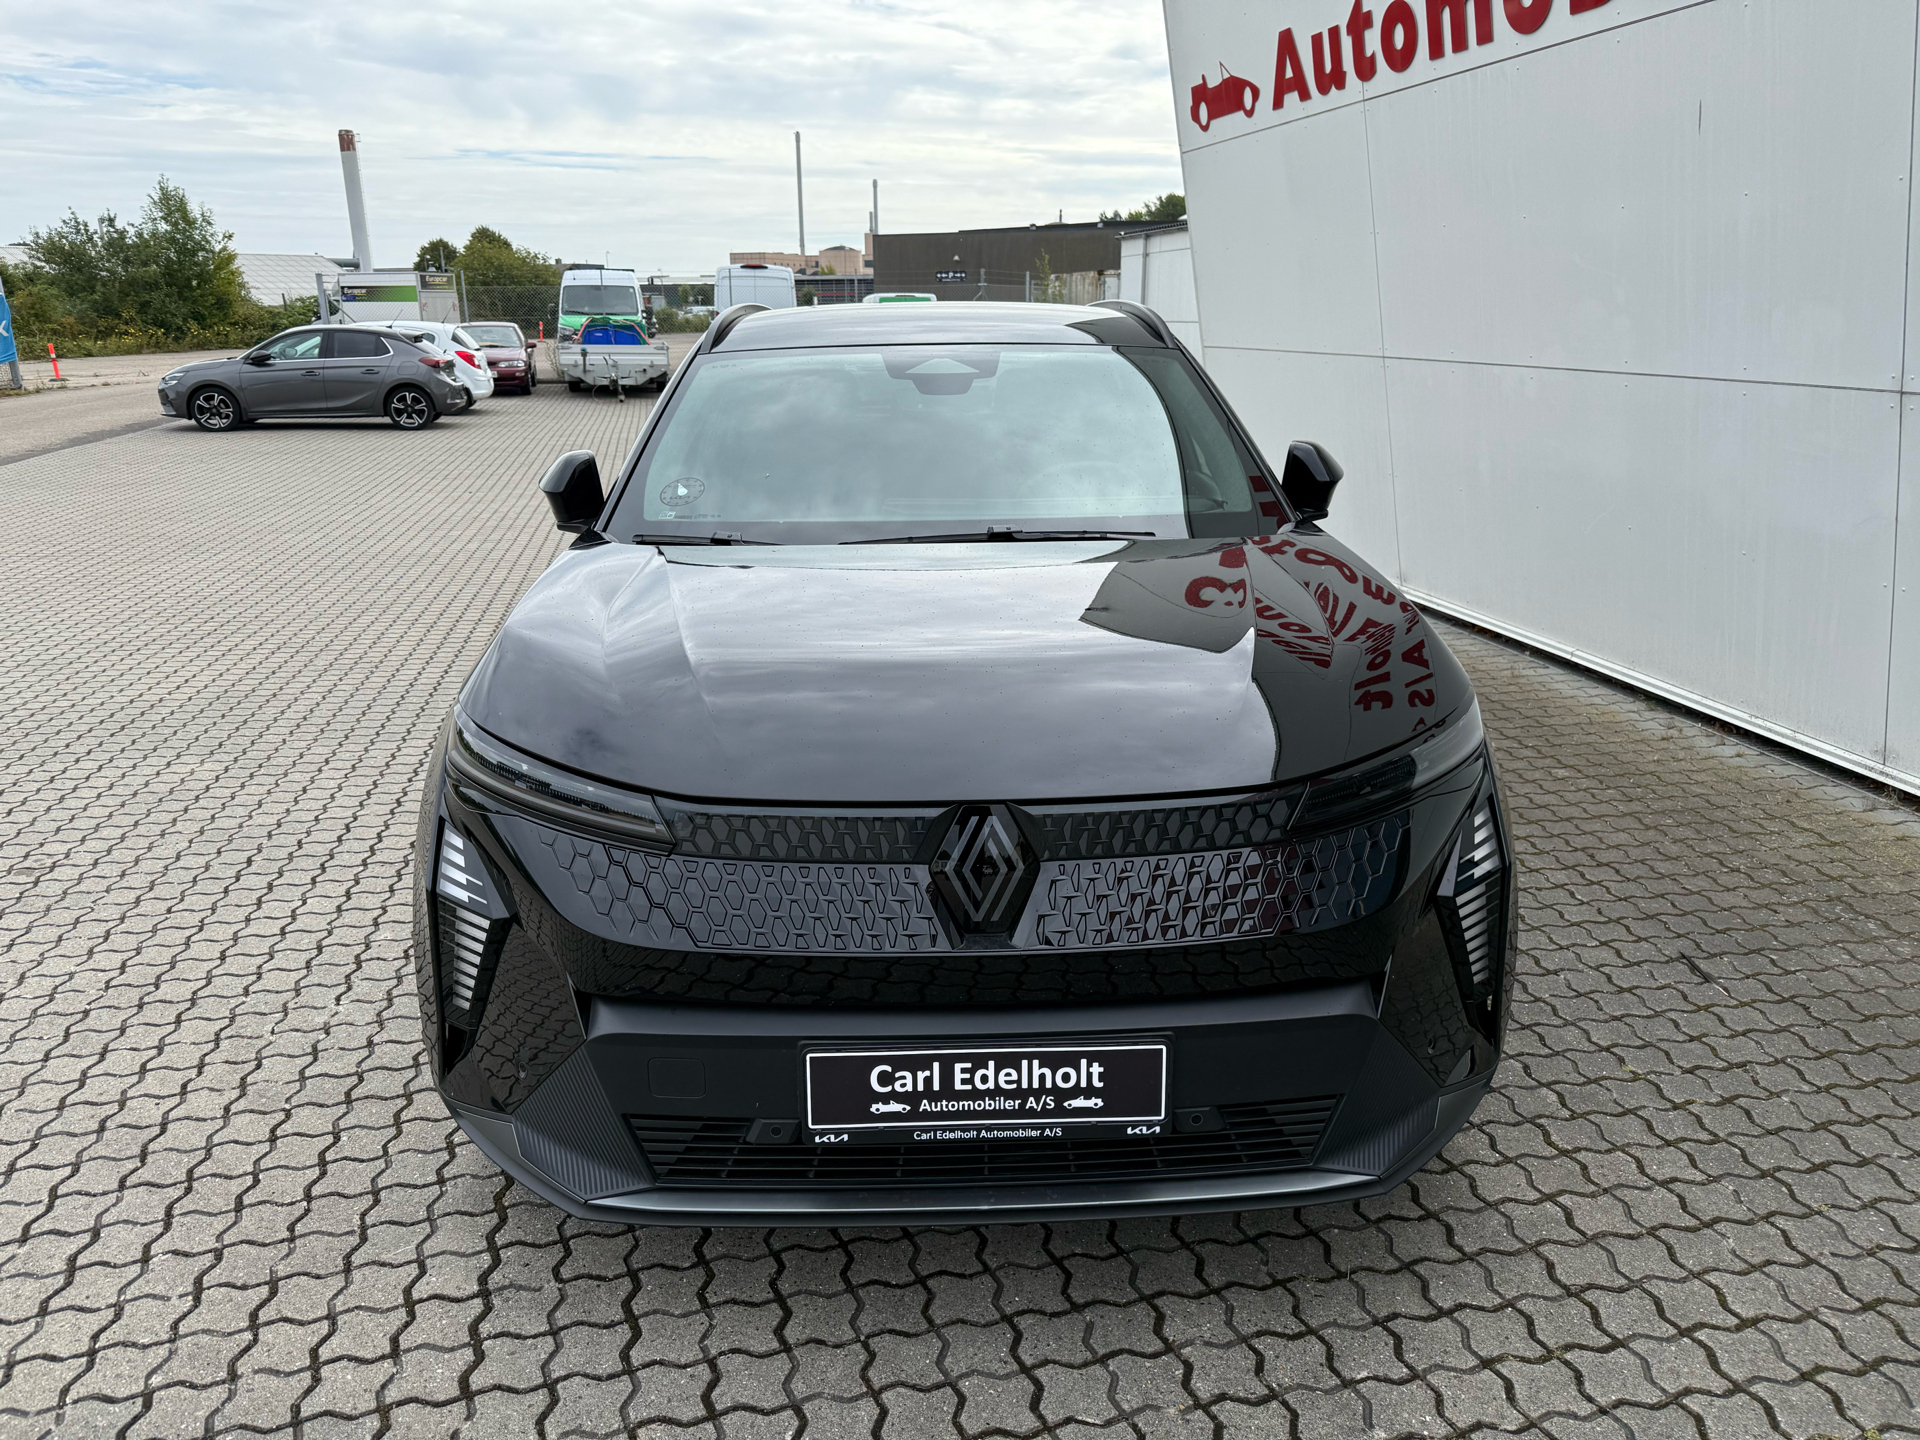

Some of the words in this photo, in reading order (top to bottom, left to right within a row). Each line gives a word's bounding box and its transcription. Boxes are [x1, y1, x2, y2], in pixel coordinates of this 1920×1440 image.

[1272, 0, 1613, 111] Autom
[426, 275, 448, 283] Europcar
[869, 1061, 940, 1093] Carl
[954, 1058, 1104, 1090] Edelholt
[919, 1097, 1021, 1112] Automobiler
[1025, 1095, 1055, 1111] A/S
[913, 1131, 934, 1140] Carl
[936, 1130, 978, 1140] Edelholt
[979, 1128, 1042, 1139] Automobiler
[1043, 1127, 1063, 1138] A/S
